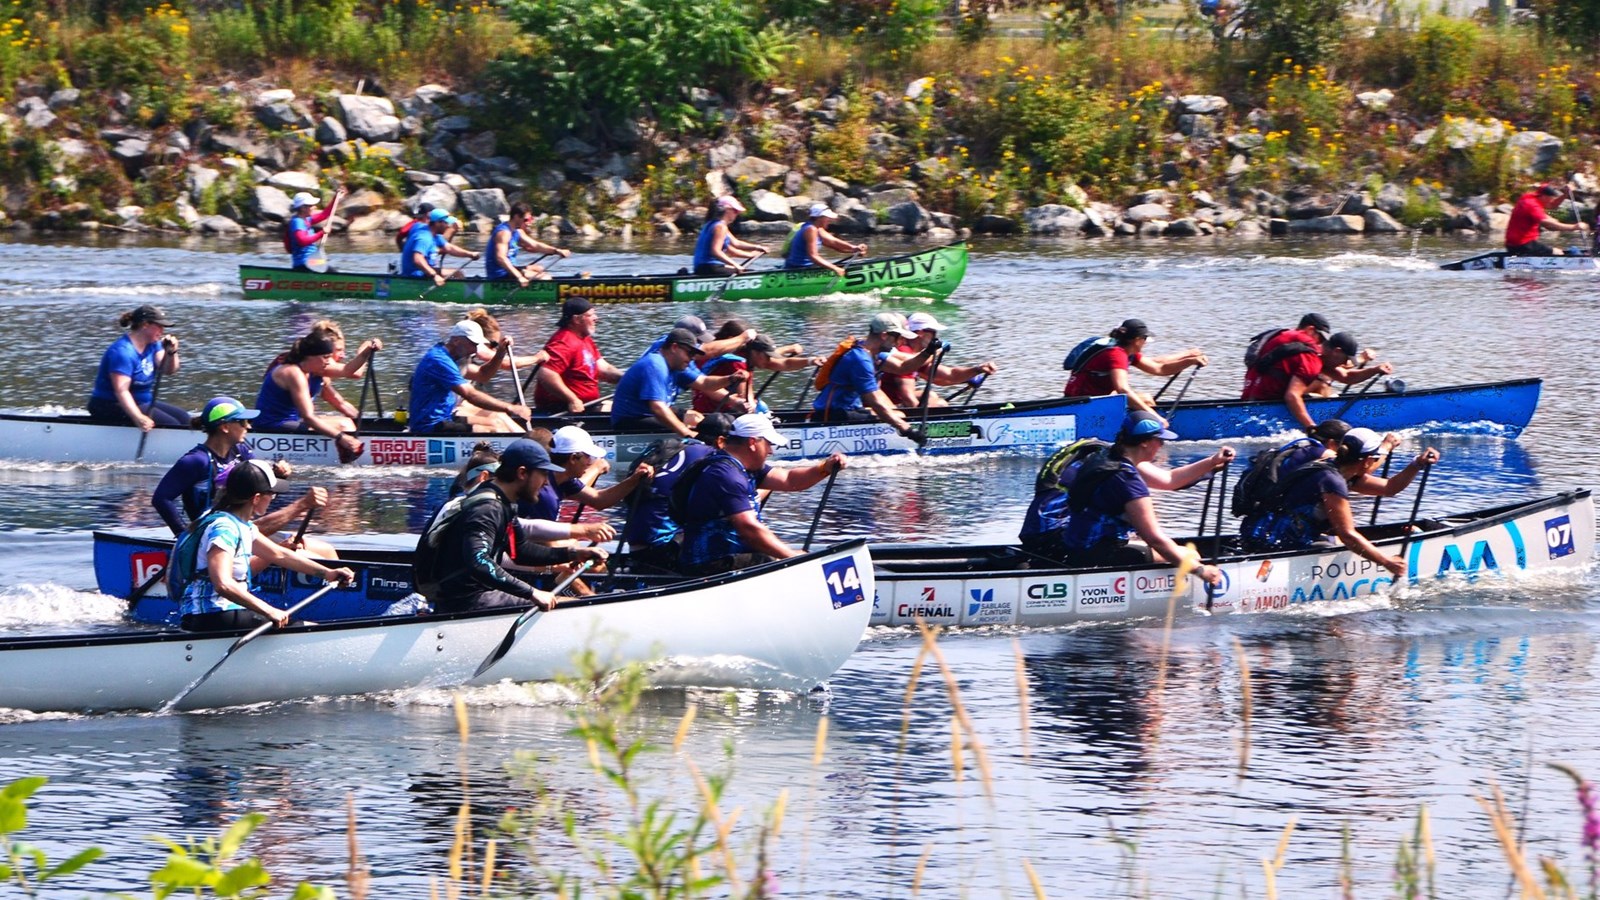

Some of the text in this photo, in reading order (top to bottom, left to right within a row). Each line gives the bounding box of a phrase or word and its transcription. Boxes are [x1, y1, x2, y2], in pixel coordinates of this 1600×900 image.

[845, 254, 936, 287] SMDV
[244, 279, 373, 291] ST GEORGES
[560, 284, 665, 297] Fondations
[804, 428, 825, 441] Les
[829, 425, 895, 439] Entreprises
[854, 438, 888, 452] DMB
[371, 453, 427, 465] DIABLE
[1547, 524, 1571, 548] 07
[827, 567, 860, 595] 14
[1027, 583, 1068, 599] CLB
[1081, 588, 1107, 596] YVON
[1081, 595, 1125, 605] COUTURE
[898, 604, 955, 618] CHENAIL
[980, 608, 1012, 616] PEINTURE
